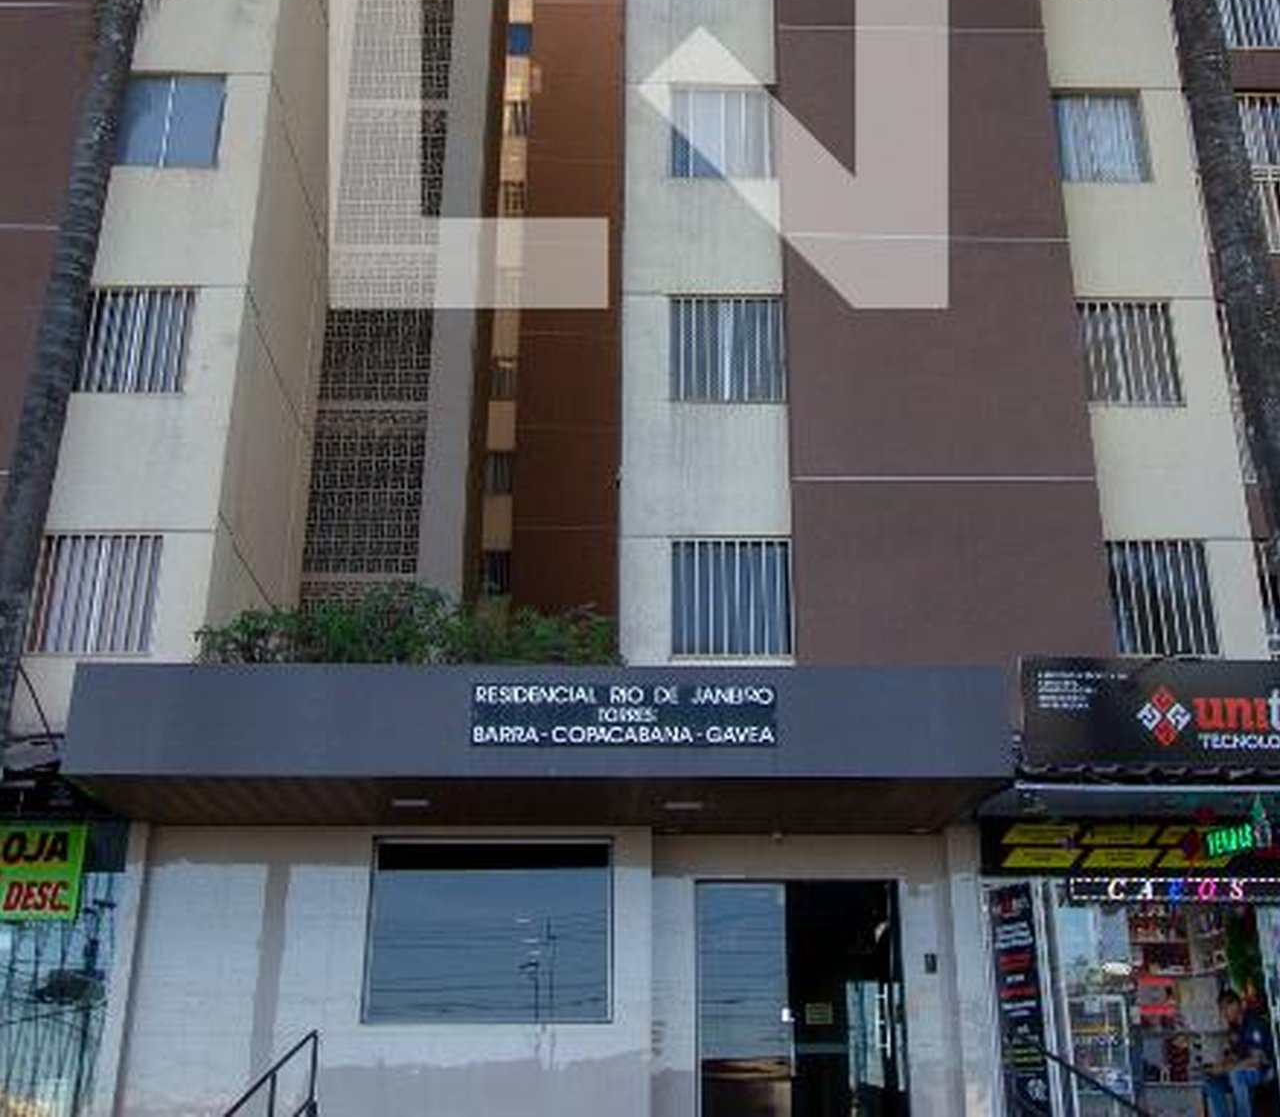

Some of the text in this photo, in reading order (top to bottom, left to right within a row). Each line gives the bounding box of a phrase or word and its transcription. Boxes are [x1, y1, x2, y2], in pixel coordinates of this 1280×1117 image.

[475, 685, 774, 704] RESIDENCIAL RIO DE JANEIRO
